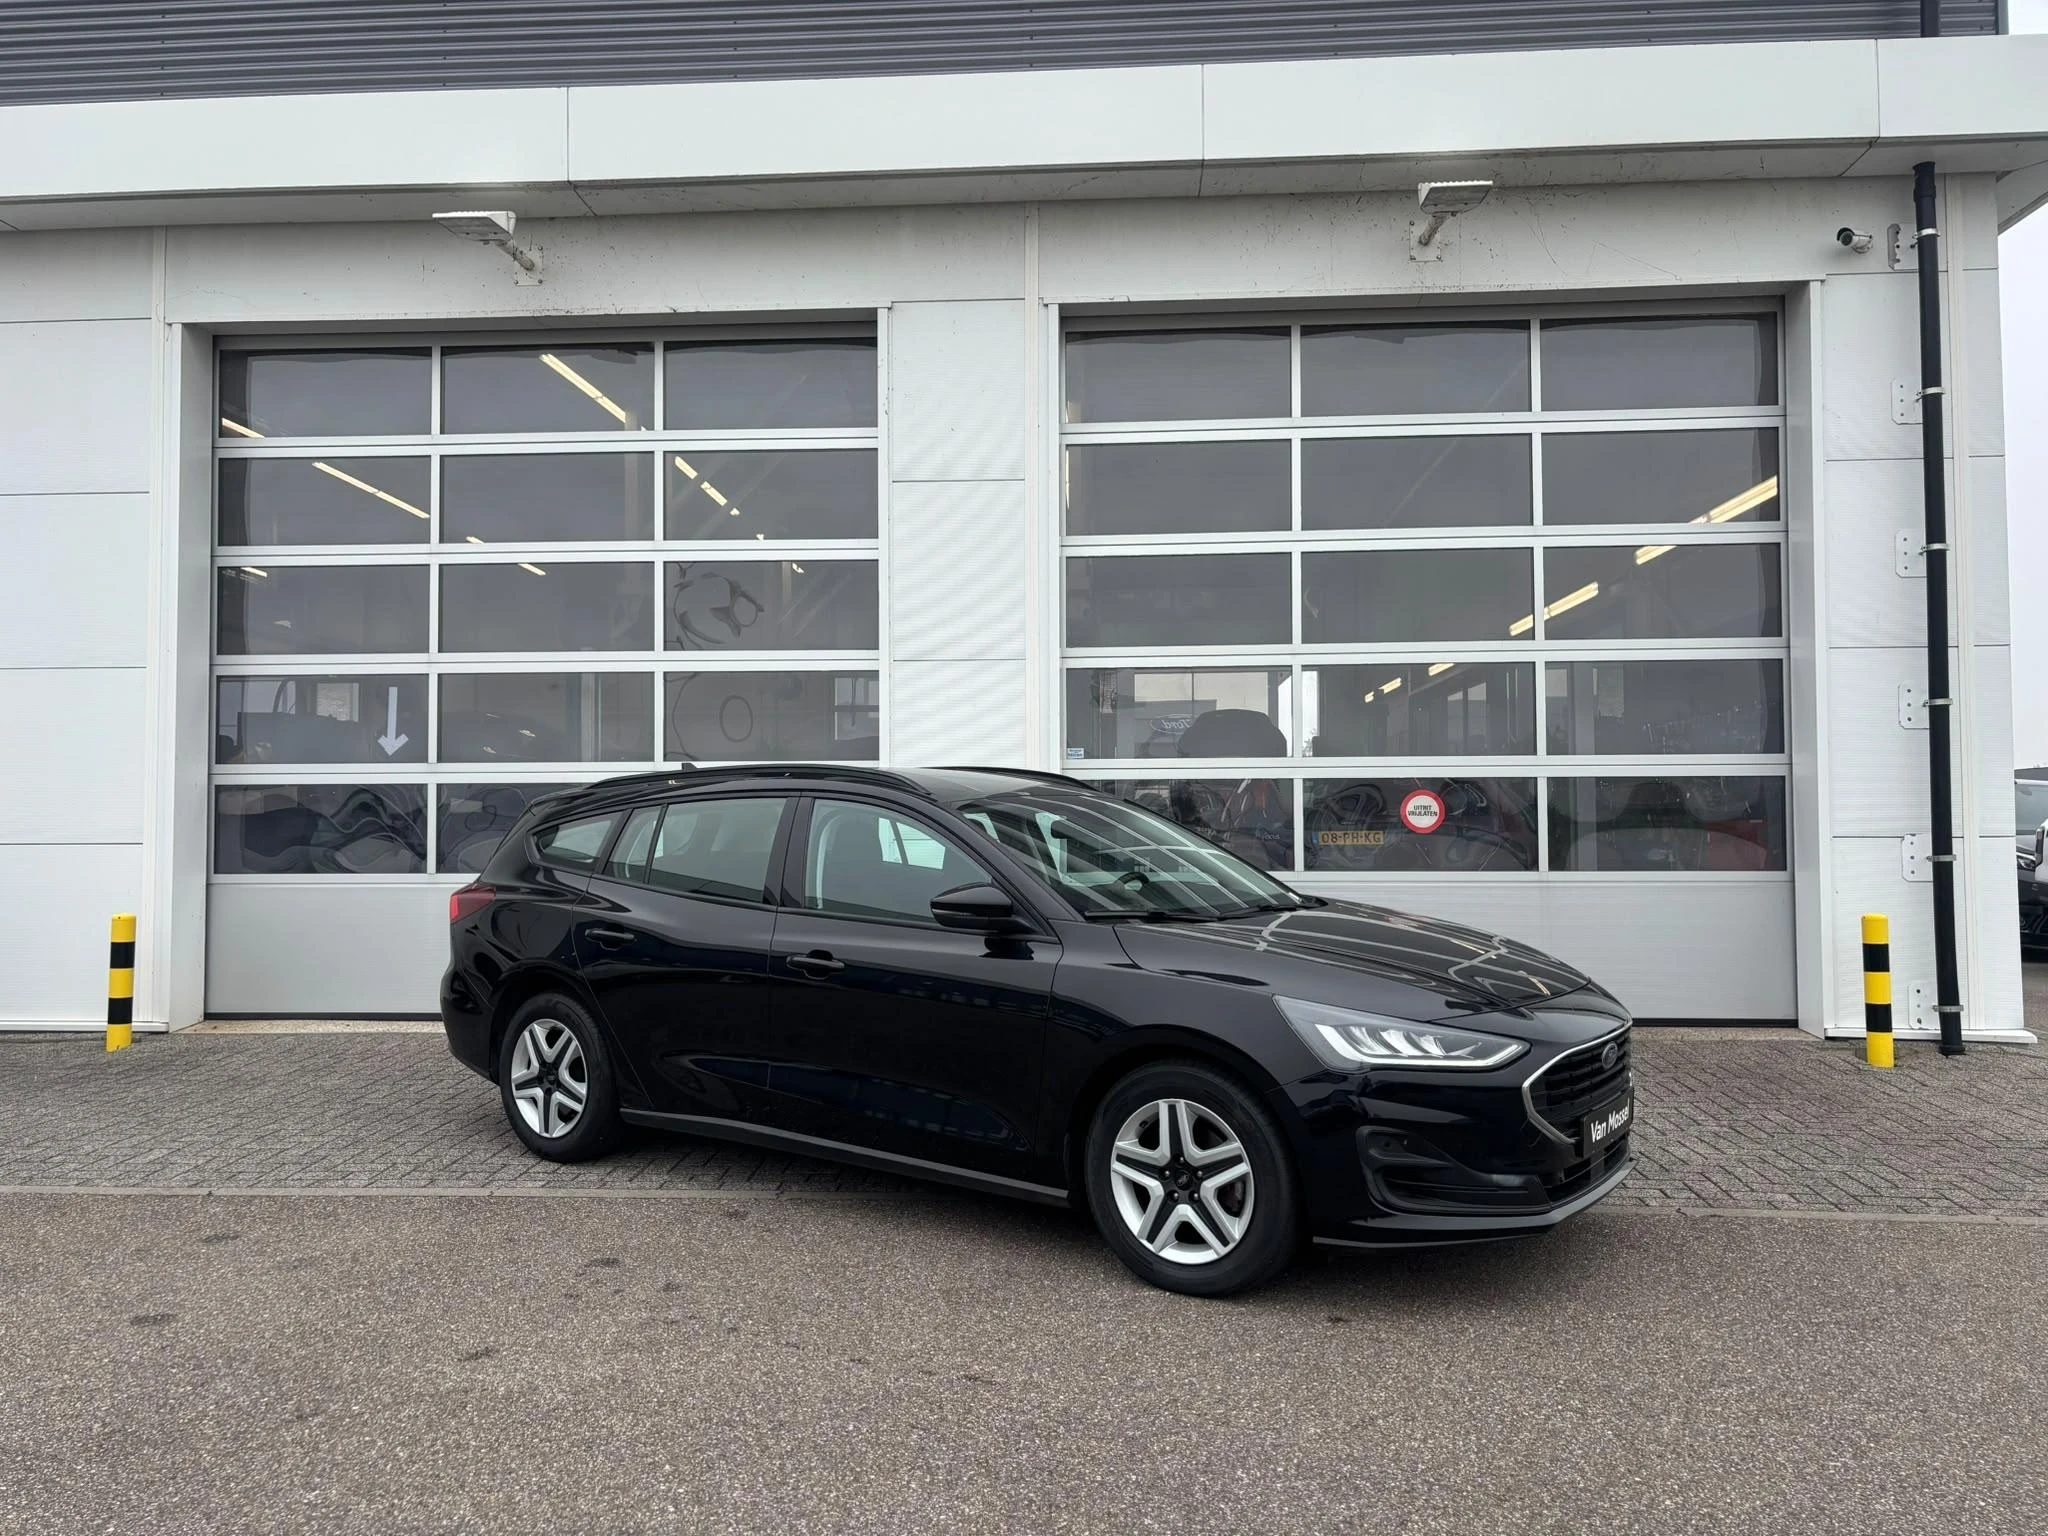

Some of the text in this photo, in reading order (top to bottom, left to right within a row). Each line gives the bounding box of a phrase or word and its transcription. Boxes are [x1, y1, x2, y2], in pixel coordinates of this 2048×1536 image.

[1321, 832, 1381, 844] 08-PH-KG
[1590, 1097, 1630, 1143] Van Mossel
